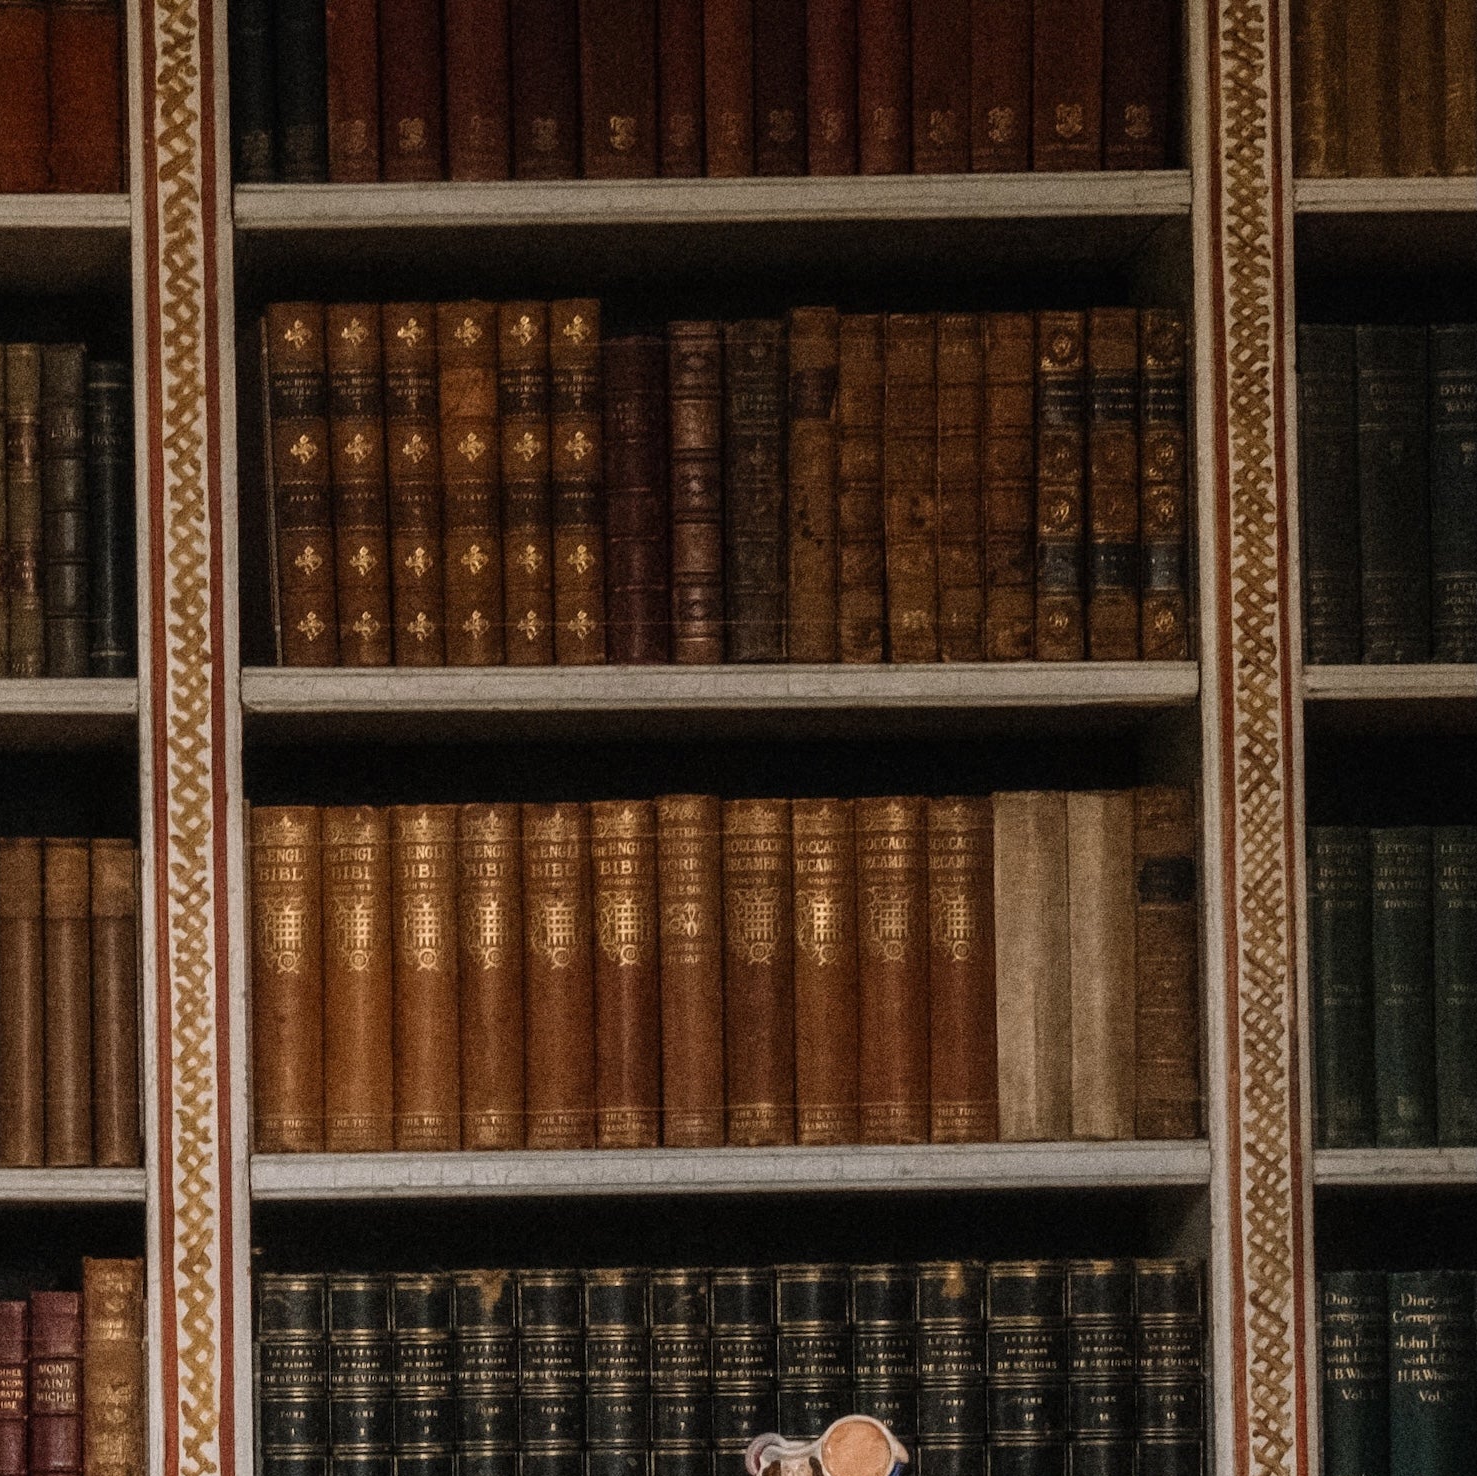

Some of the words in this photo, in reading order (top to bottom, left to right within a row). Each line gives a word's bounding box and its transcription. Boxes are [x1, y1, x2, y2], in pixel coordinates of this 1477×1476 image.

[91, 434, 122, 445] DANT
[608, 841, 647, 856] ENGLI
[663, 841, 702, 855] GEOR
[728, 838, 781, 852] OCCACC
[797, 840, 841, 854] OCCACC
[860, 836, 911, 850] OCCACC
[931, 836, 971, 850] OCCAC
[1376, 844, 1424, 853] LETTER
[267, 847, 307, 863] ENGLI
[339, 848, 379, 863] ENGL
[406, 845, 446, 860] ENGLI
[540, 844, 579, 858] ENGLI
[600, 860, 642, 875] BIBL
[662, 857, 700, 871] ORR
[727, 857, 780, 871] ECAMER
[795, 858, 838, 873] DECAME
[930, 854, 971, 869] DECAM
[259, 867, 307, 882] BIBL
[331, 865, 374, 881] BIBL
[402, 863, 445, 878] BIBL
[464, 862, 506, 878] BIBL
[530, 862, 579, 878] BIBL
[1317, 881, 1357, 890] WALPO
[1376, 881, 1422, 891] WALPOL
[1400, 1292, 1437, 1310] Diary
[1395, 1334, 1429, 1349] John
